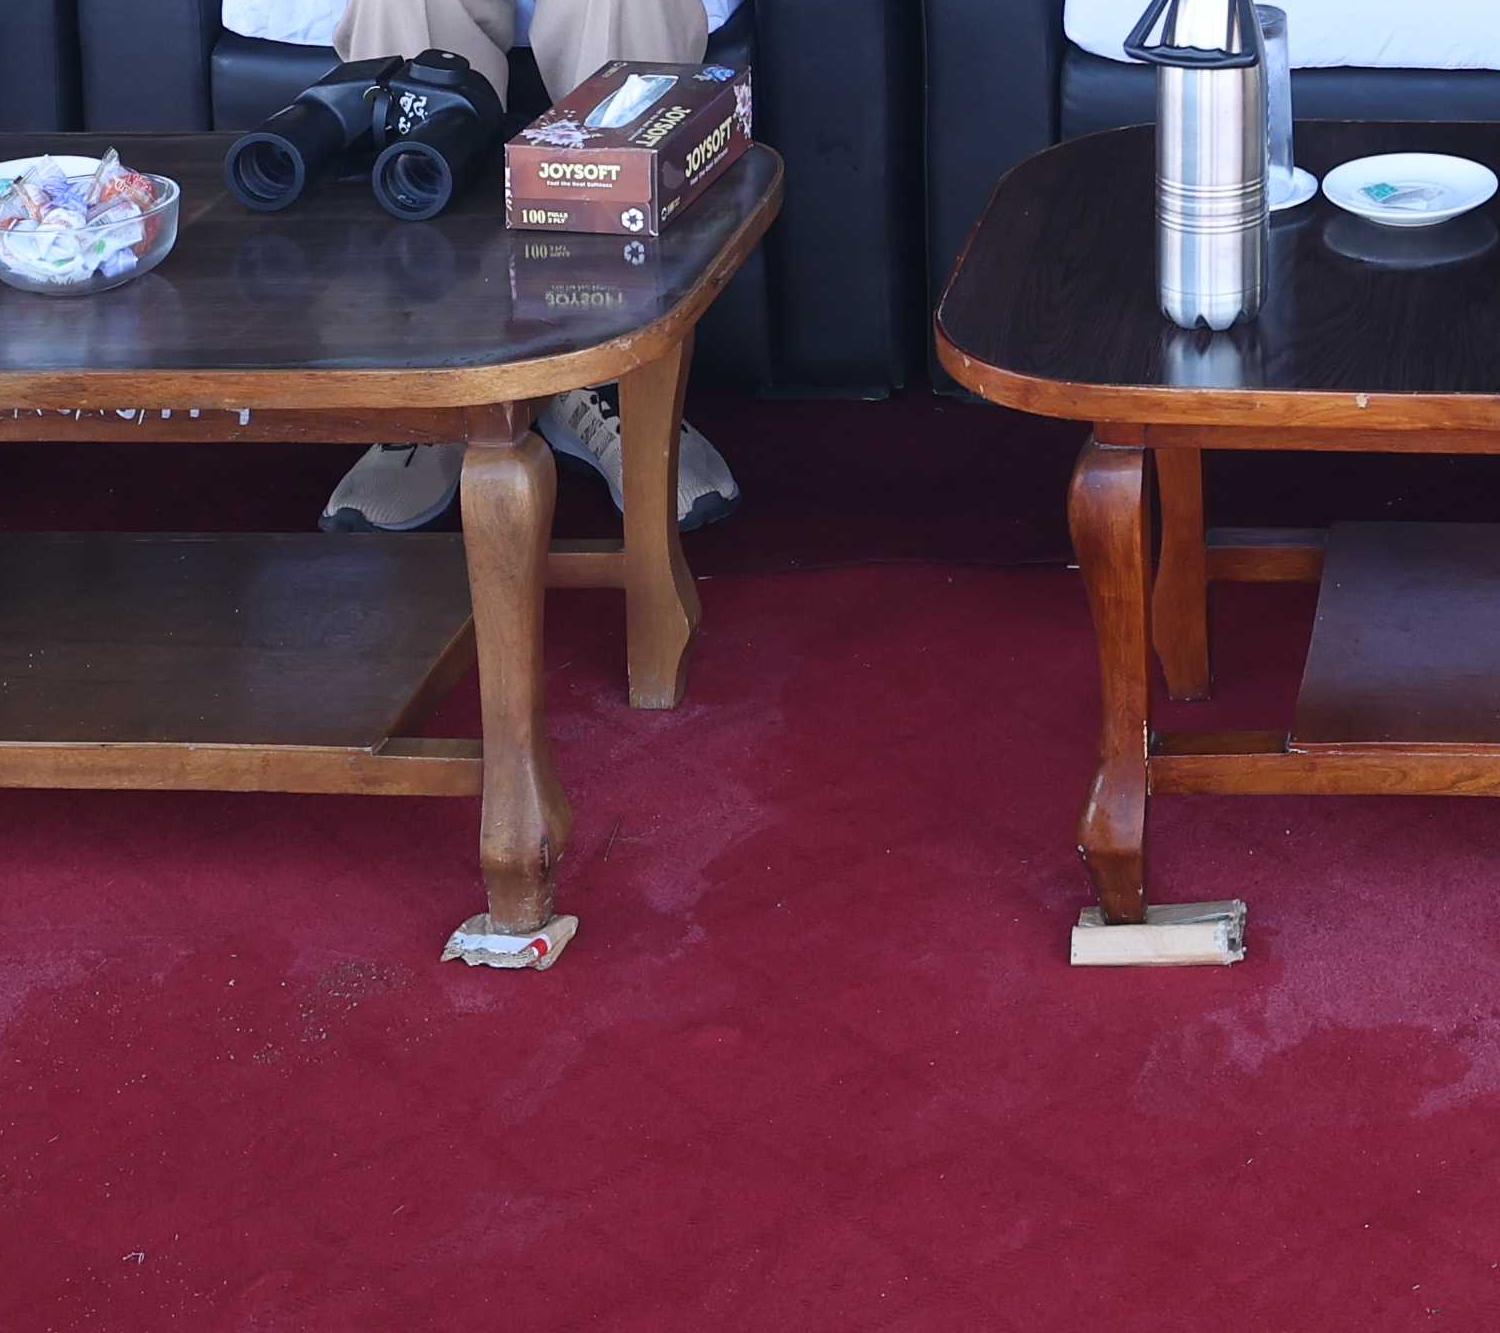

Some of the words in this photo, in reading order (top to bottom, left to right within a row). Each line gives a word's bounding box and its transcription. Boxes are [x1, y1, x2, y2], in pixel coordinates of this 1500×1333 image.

[636, 106, 692, 147] JOYSOFT
[685, 115, 733, 178] JOYSOFT
[539, 162, 620, 181] JOYSOFT
[521, 209, 546, 224] 100
